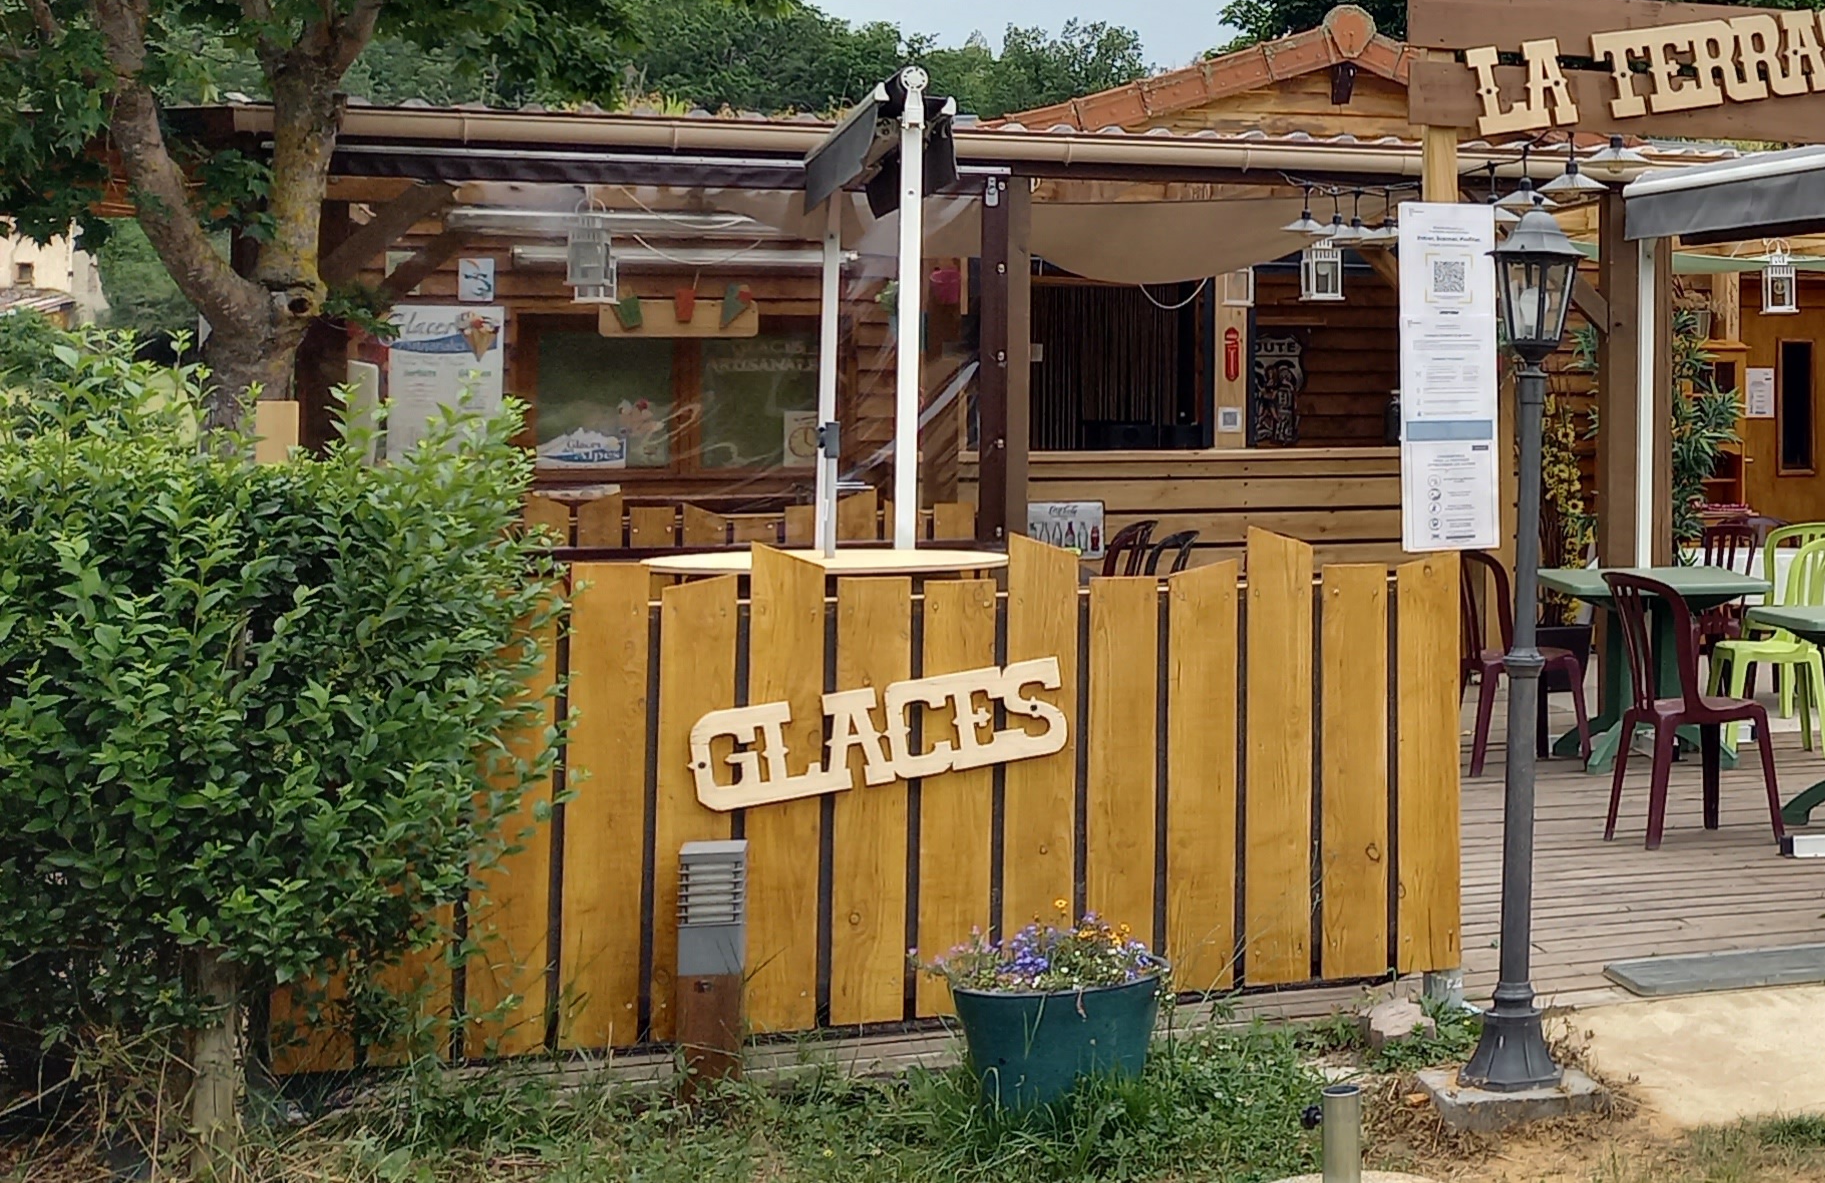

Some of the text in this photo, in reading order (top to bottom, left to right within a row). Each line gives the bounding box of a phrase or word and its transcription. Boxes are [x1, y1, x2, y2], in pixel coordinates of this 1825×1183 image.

[1465, 37, 1579, 136] LA
[1255, 341, 1297, 353] OUTE
[687, 656, 1068, 812] GLACES
